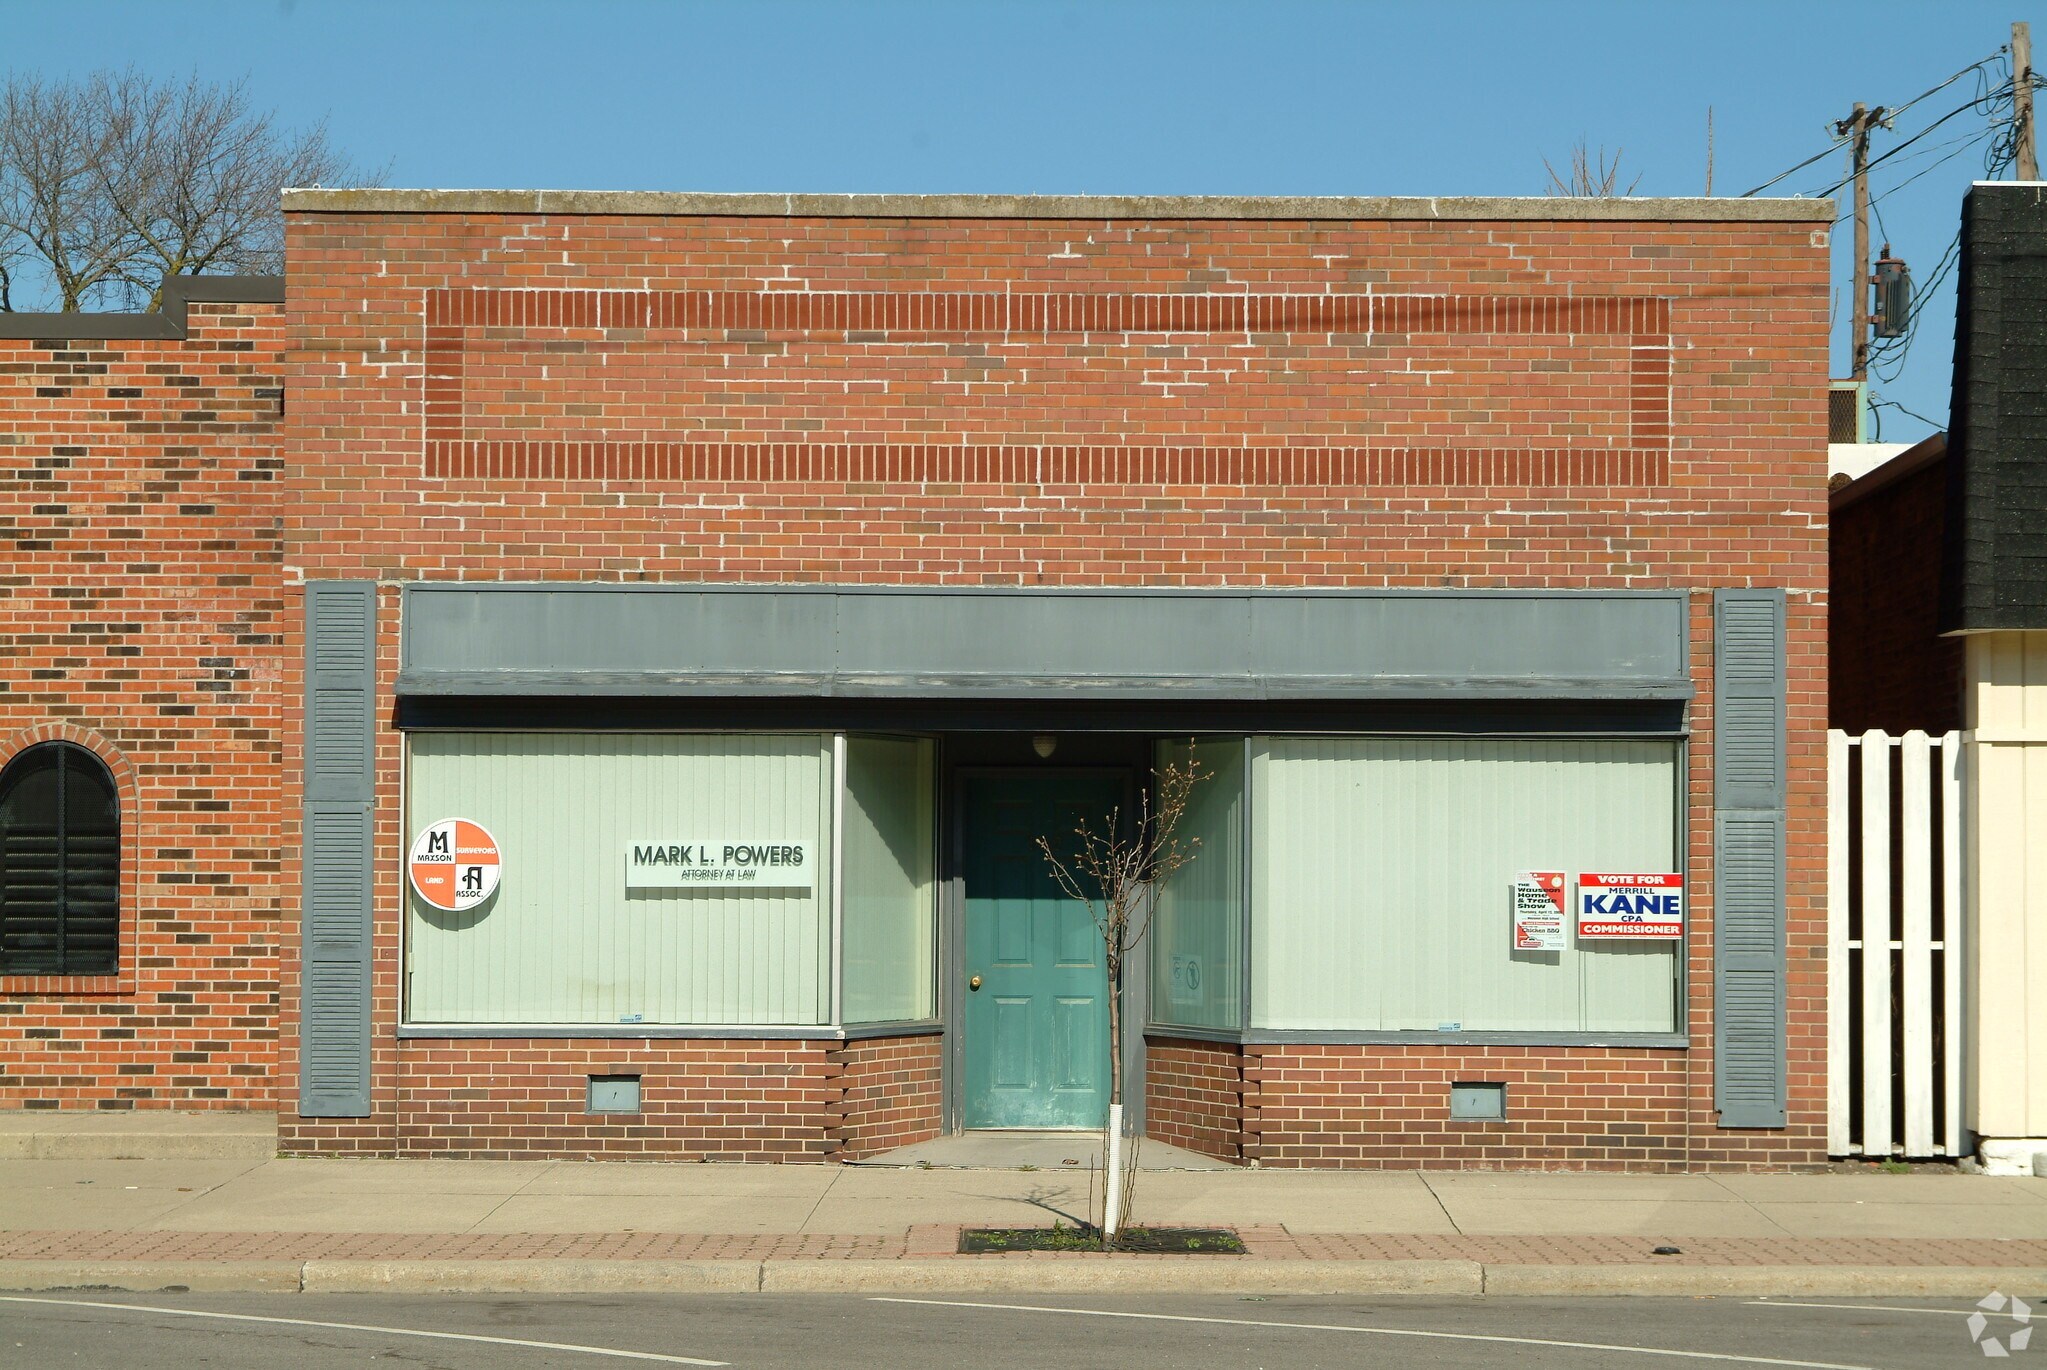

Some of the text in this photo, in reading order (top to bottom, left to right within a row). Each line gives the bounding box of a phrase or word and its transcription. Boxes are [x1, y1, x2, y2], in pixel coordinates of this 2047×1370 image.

[427, 831, 449, 854] M
[634, 845, 804, 865] MARK L. POWERS
[681, 869, 757, 879] ATTORNEY AT LAW
[1597, 875, 1665, 885] VOTE FOR
[456, 890, 483, 898] ASSOC.
[1584, 894, 1680, 915] KANE
[1583, 924, 1680, 934] COMMISSIONER
